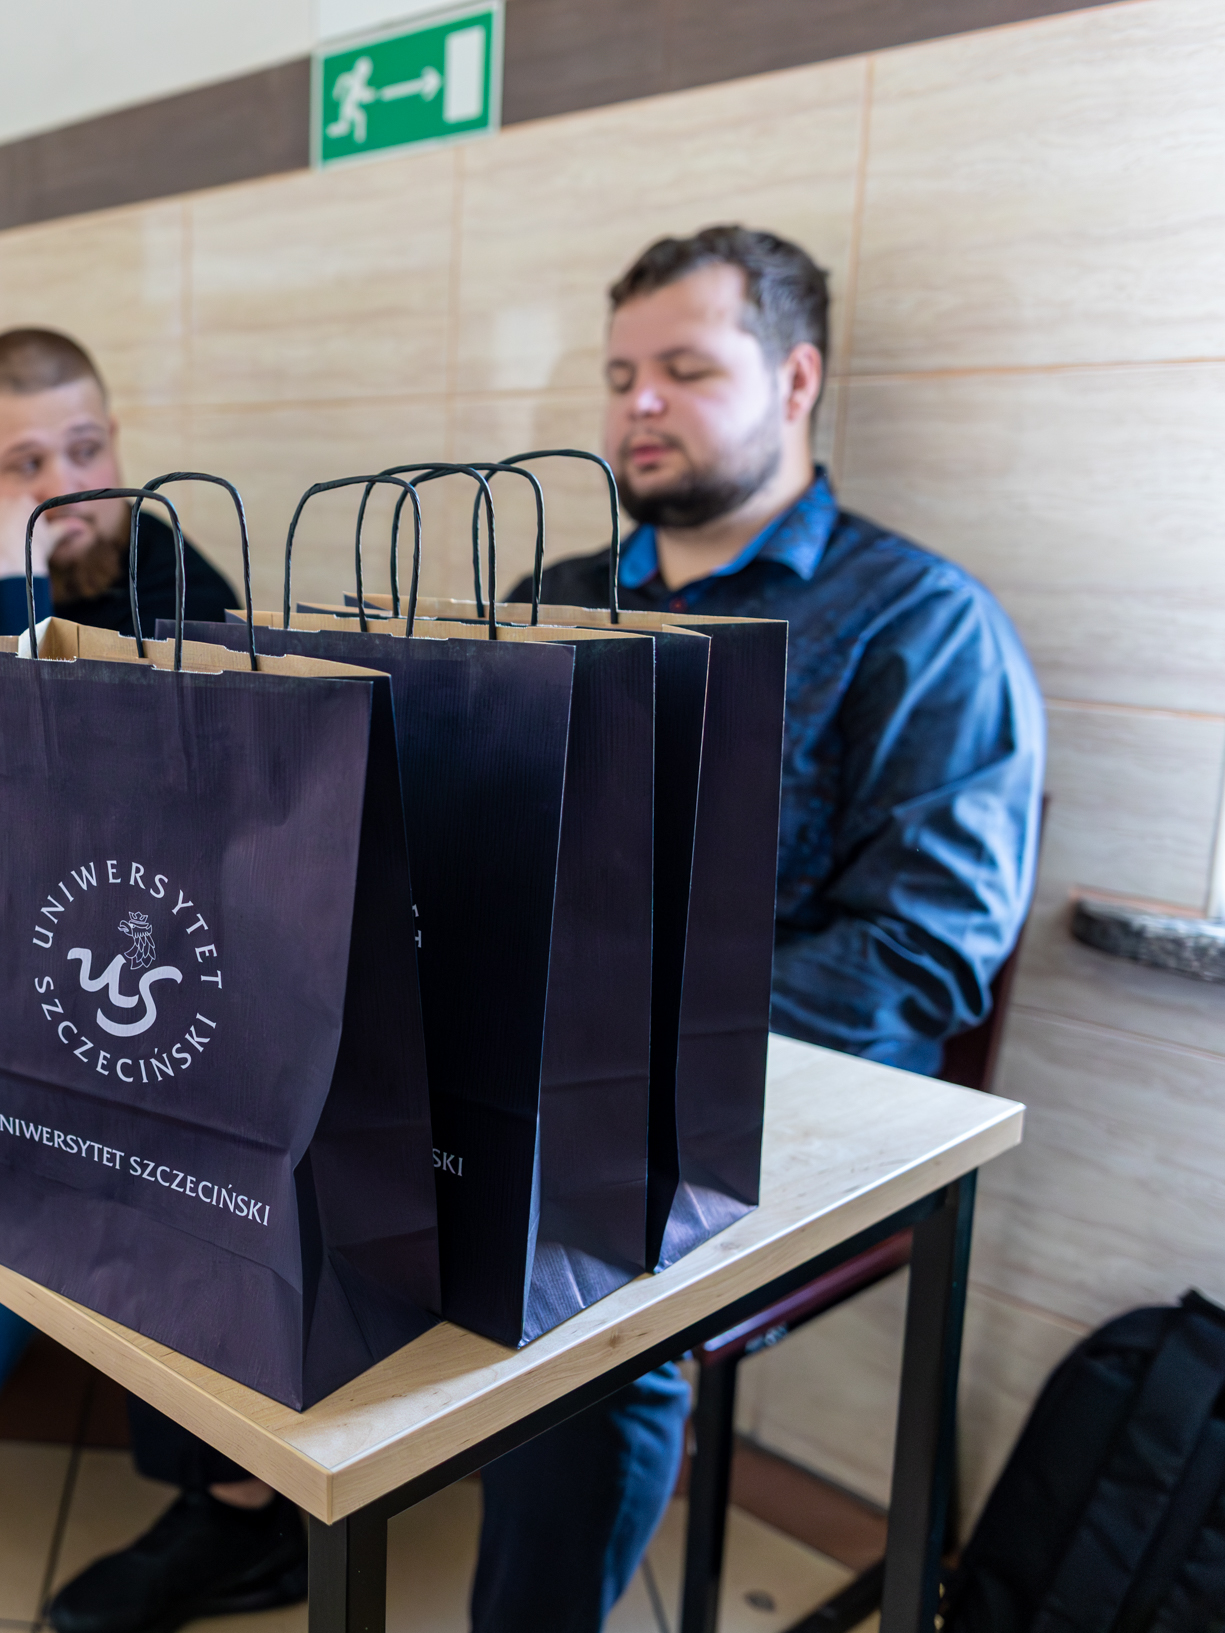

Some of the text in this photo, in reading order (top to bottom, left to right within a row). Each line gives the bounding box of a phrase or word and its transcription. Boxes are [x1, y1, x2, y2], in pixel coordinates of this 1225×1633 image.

[32, 860, 223, 989] UNIWERSYTET
[34, 975, 217, 1083] SZCZECIŃSKI
[129, 1156, 271, 1227] SZCZECIŃSKI
